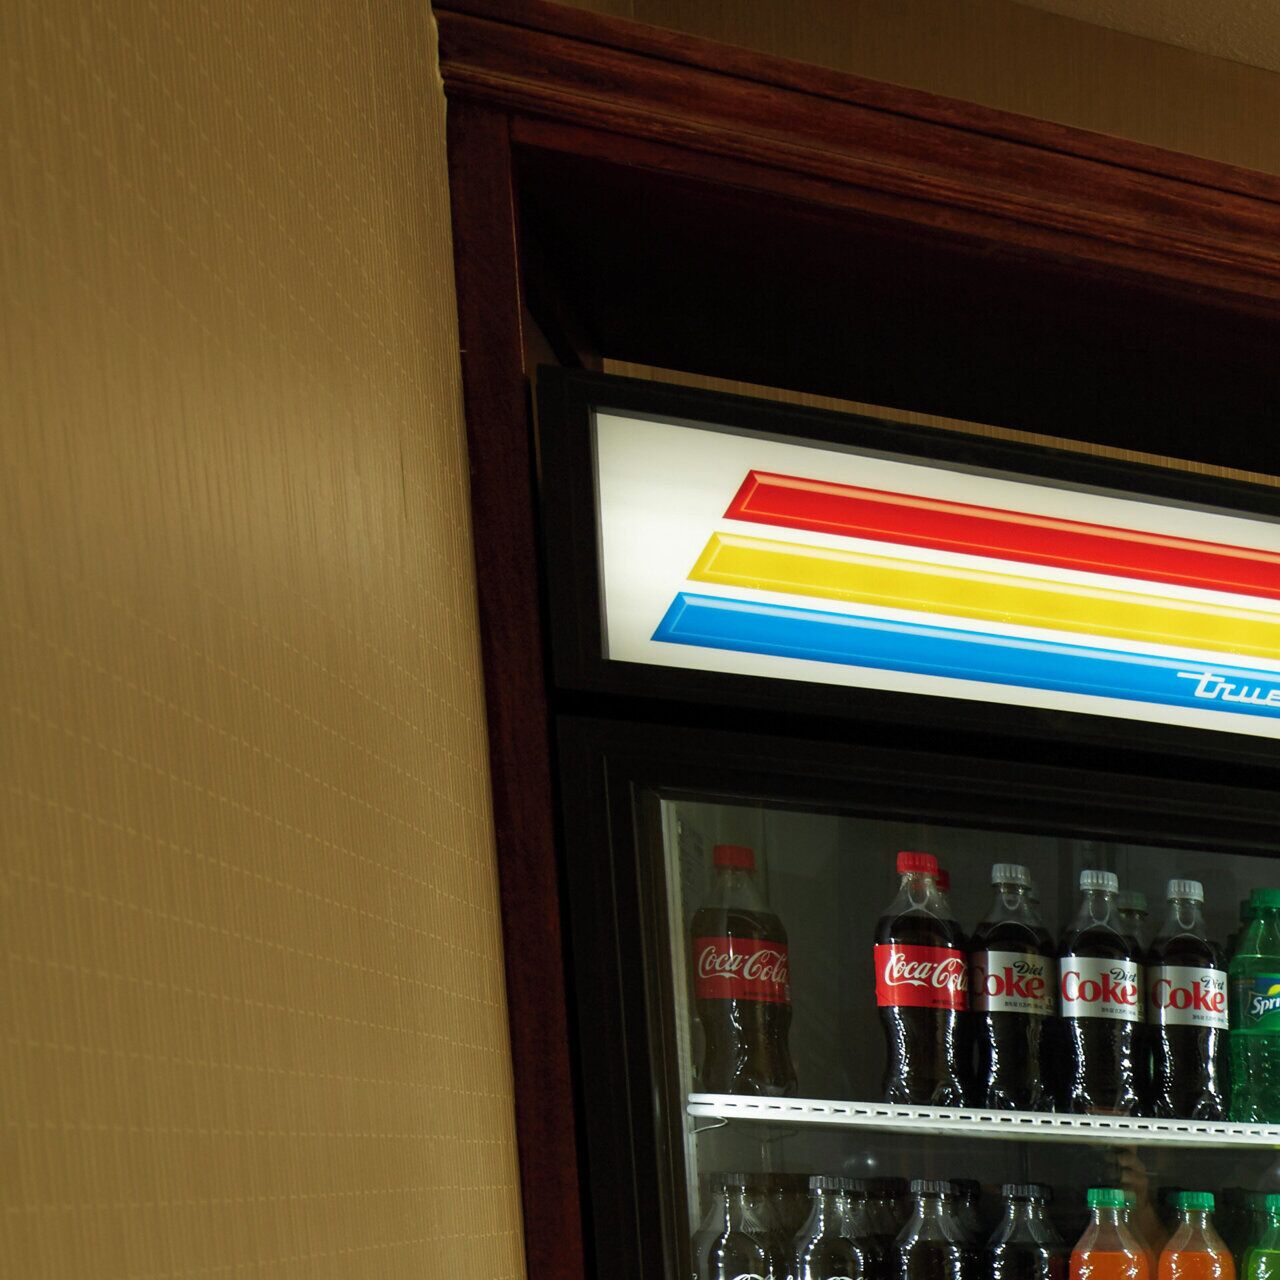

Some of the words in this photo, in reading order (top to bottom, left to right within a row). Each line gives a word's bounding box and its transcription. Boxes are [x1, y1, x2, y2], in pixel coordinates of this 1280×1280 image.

[699, 945, 790, 985] Coca-Cola
[973, 965, 1045, 999] Coke
[1013, 960, 1044, 976] Diet
[1110, 967, 1136, 982] Diet
[1061, 971, 1138, 1006] Coke
[1152, 978, 1226, 1014] Coke
